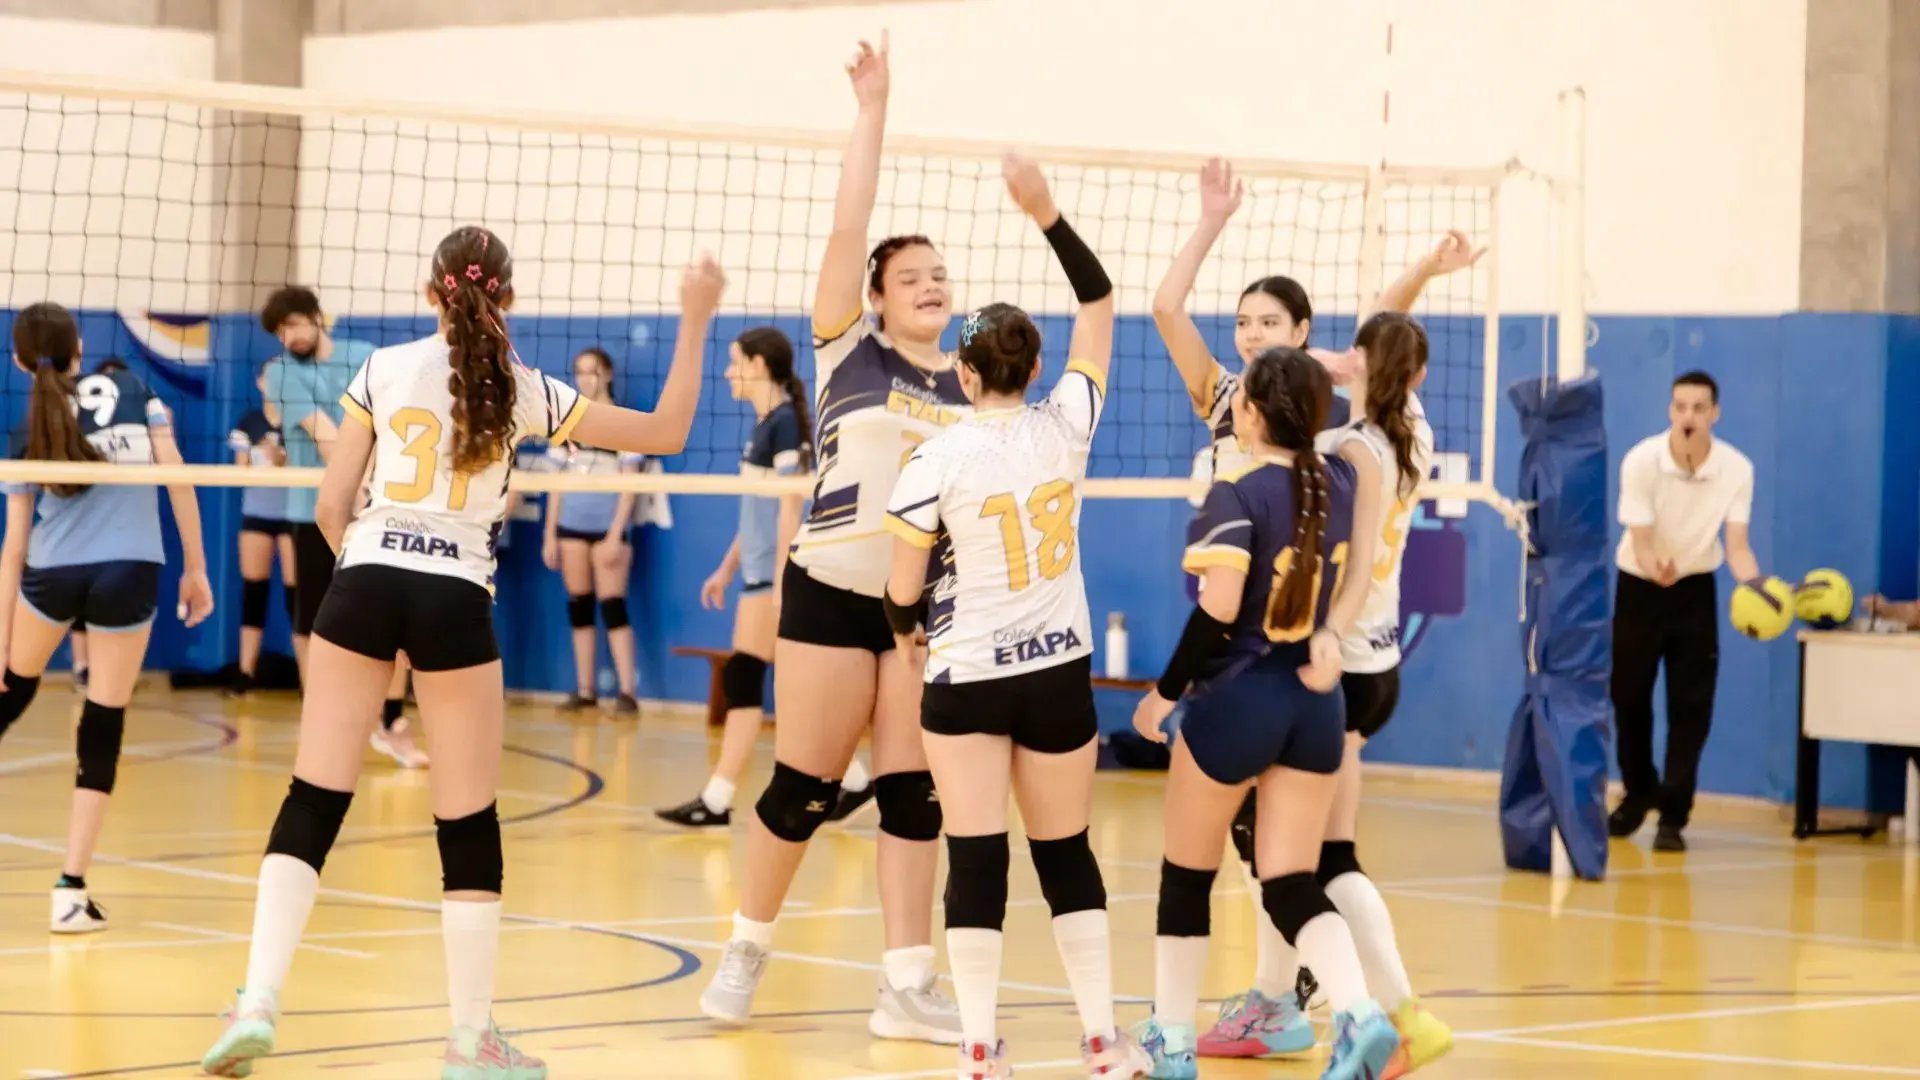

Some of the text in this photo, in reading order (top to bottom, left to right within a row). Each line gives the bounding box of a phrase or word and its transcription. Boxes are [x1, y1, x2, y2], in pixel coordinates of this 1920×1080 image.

[68, 374, 119, 427] 9
[886, 390, 961, 428] ETAP
[381, 531, 460, 560] ETAPA
[979, 478, 1075, 591] 18
[995, 626, 1081, 666] ETAPA
